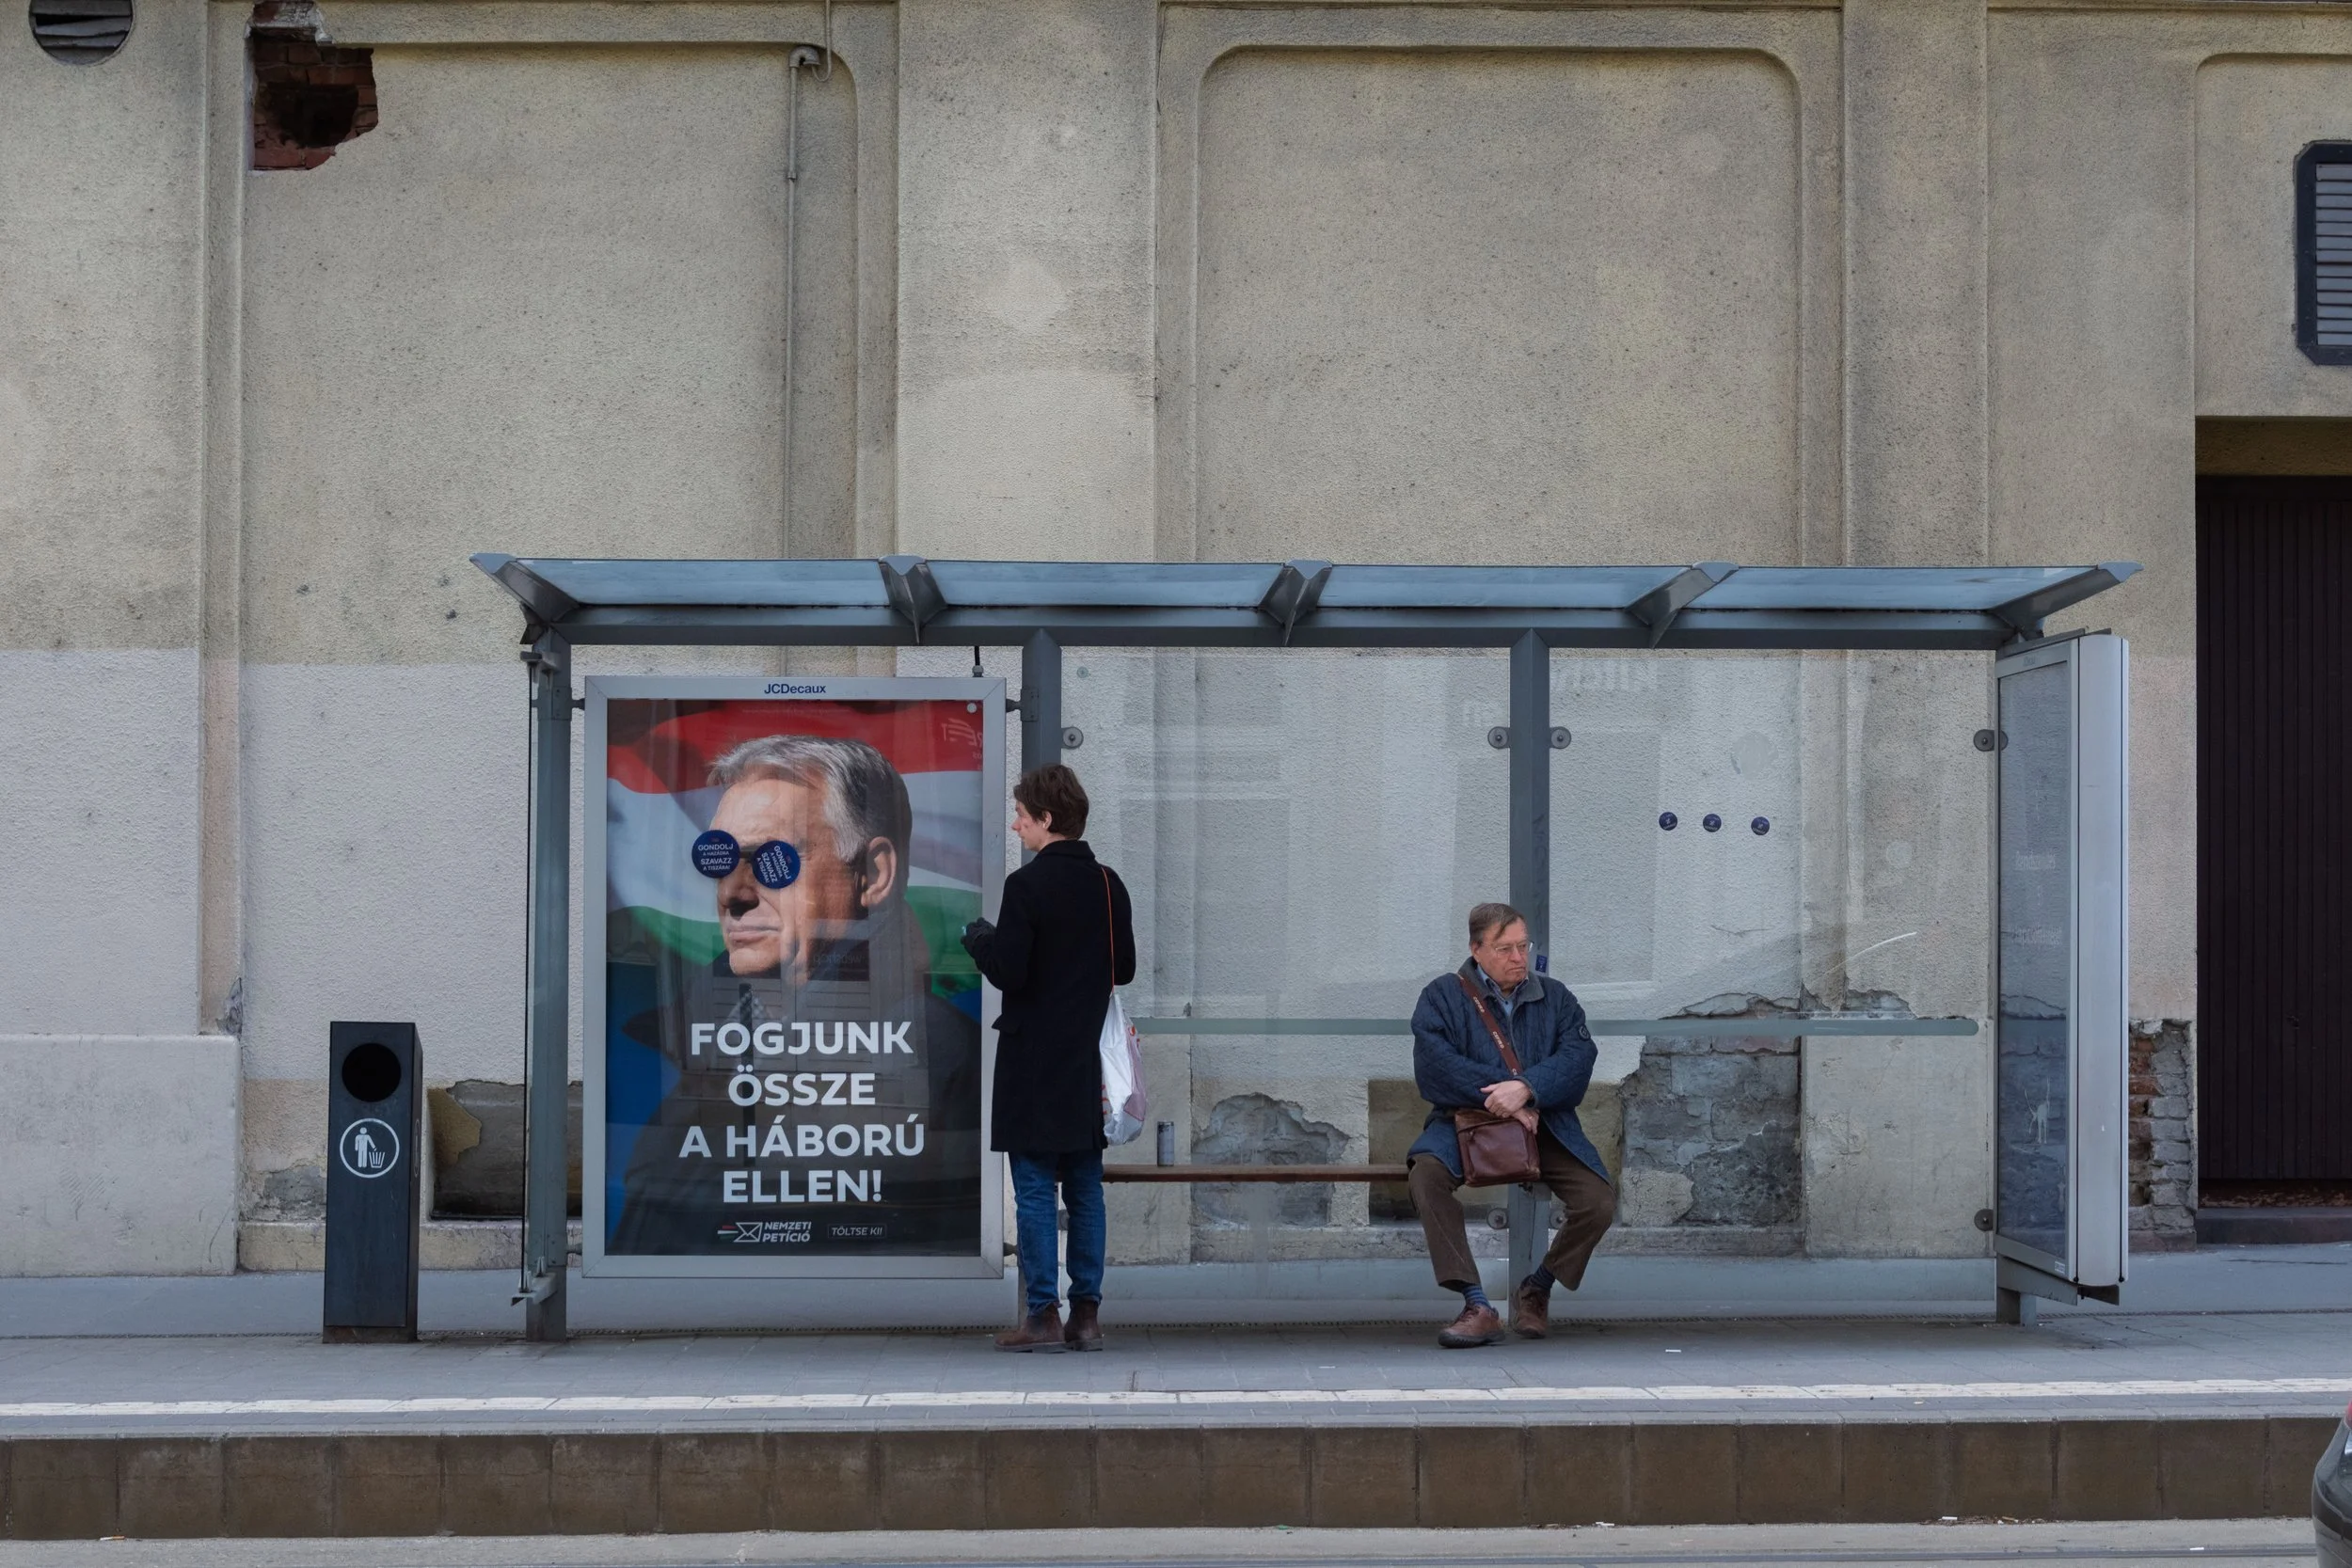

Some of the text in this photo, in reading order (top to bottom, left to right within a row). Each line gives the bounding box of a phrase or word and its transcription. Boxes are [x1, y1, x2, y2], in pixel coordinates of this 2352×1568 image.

[764, 683, 827, 694] JCDecaux
[697, 843, 734, 851] GONDOLJ
[700, 857, 732, 865] SZAVAZZ
[761, 851, 778, 883] SZAVAZZ
[773, 845, 791, 879] GONDOLJ
[691, 1021, 914, 1055] FOGJUNK
[728, 1065, 876, 1106] ÖSSZE
[679, 1113, 925, 1158] A HÁBORÚ
[723, 1169, 882, 1203] ELLEN!
[762, 1230, 811, 1243] PETÍCIÓ
[764, 1221, 812, 1230] NEMZETI
[832, 1226, 882, 1236] TÖLTSE KI!
